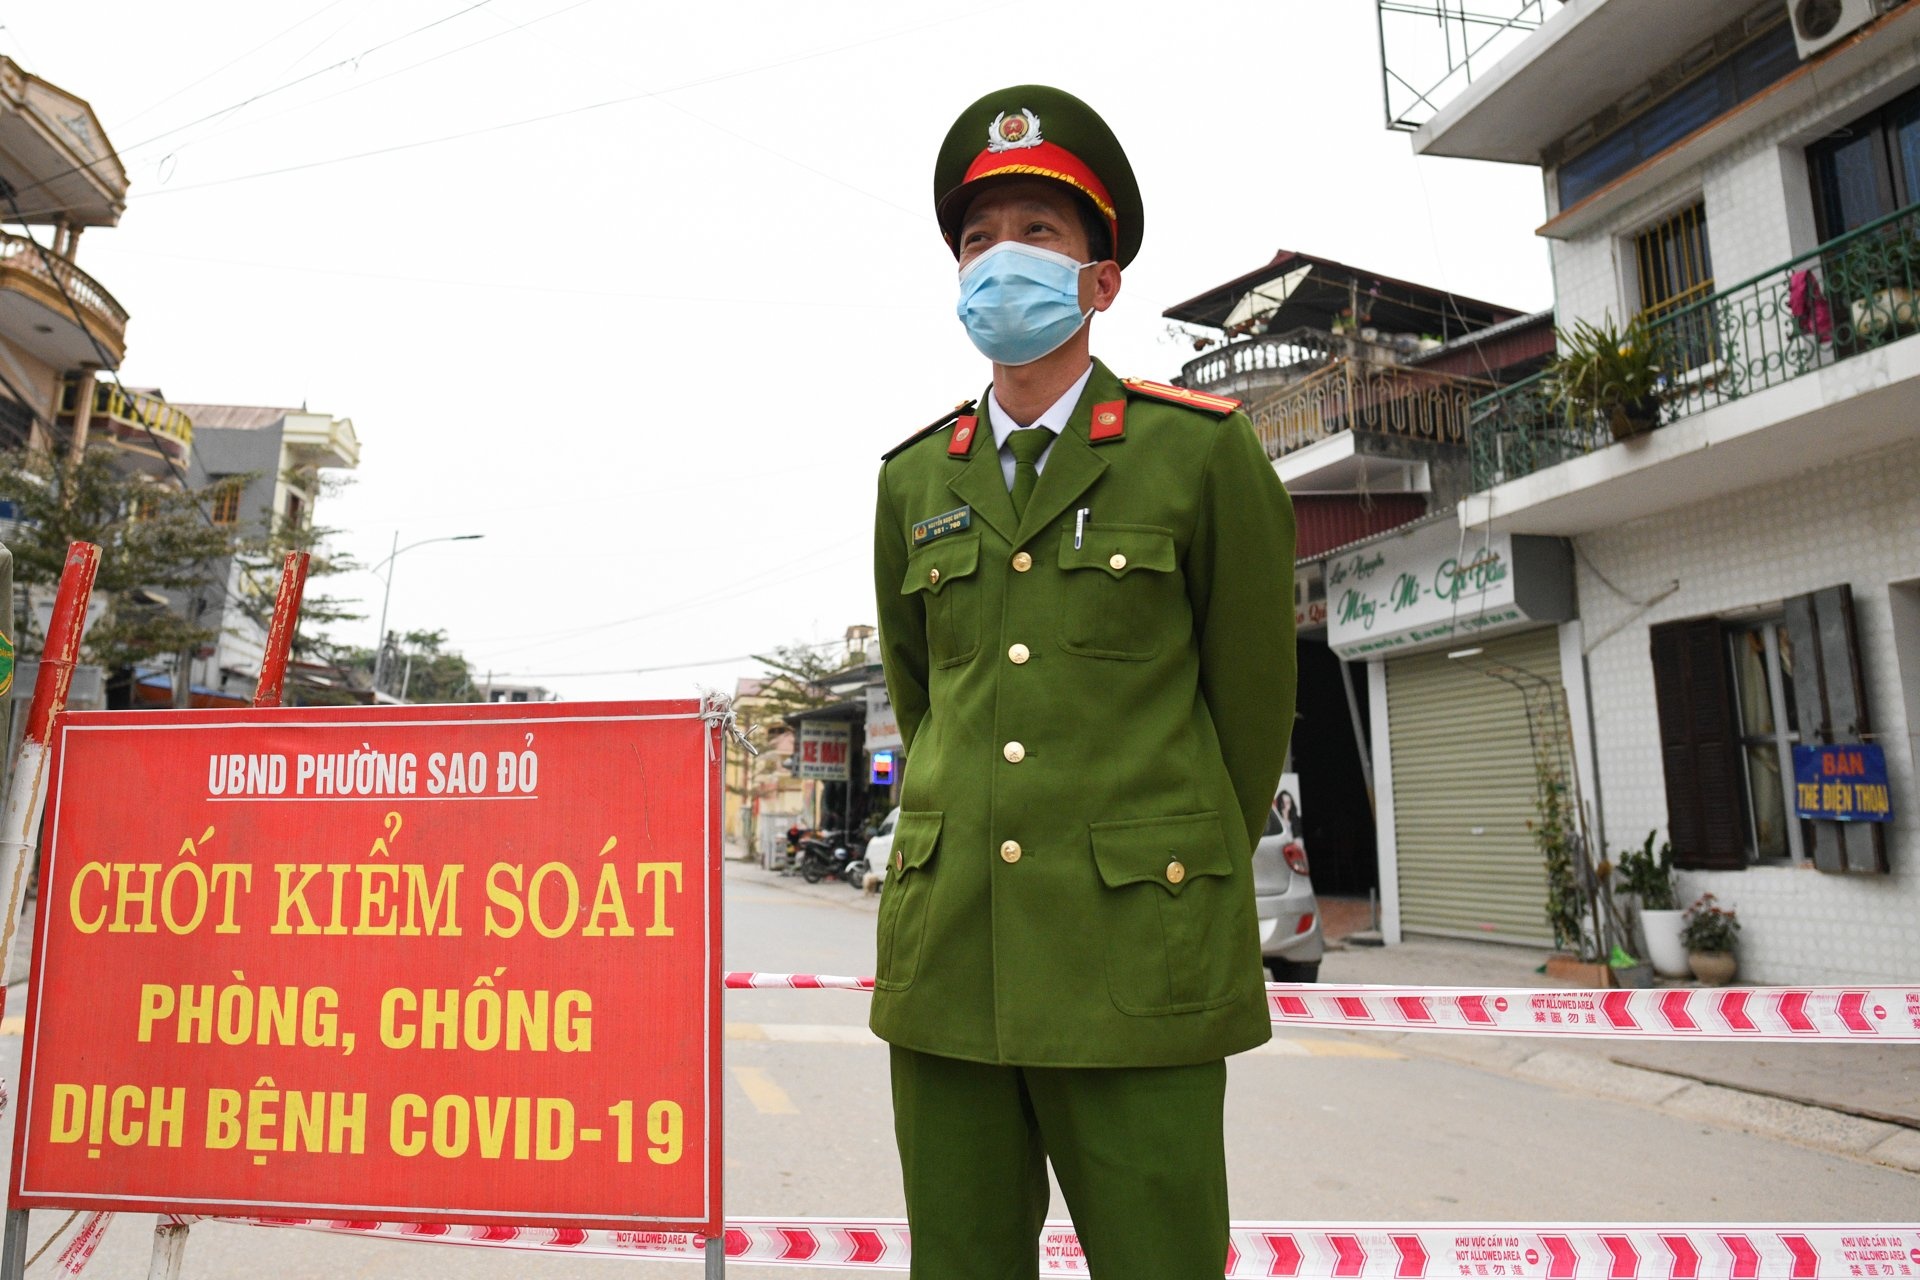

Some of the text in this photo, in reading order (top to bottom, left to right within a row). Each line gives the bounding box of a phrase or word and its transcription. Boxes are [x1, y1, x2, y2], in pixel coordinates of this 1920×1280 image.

[208, 732, 538, 796] UBND PHƯỜNG SAO ĐỎ
[69, 811, 684, 939] CHỐT KIỂM SOÁT
[1531, 999, 1595, 1010] NOT ALLOWED AREA
[137, 966, 593, 1056] PHÒNG, CHỐNG
[49, 1076, 684, 1166] DỊCH BỆNH COVID-19
[616, 1232, 688, 1245] NOT ALLOWED AREA
[1455, 1237, 1470, 1247] KHU
[1841, 1236, 1856, 1247] KHU
[1046, 1246, 1060, 1257] NOT
[1456, 1250, 1522, 1261] NOT ALLOWED AREA
[1844, 1250, 1907, 1261] NOT ALLOWED AREA
